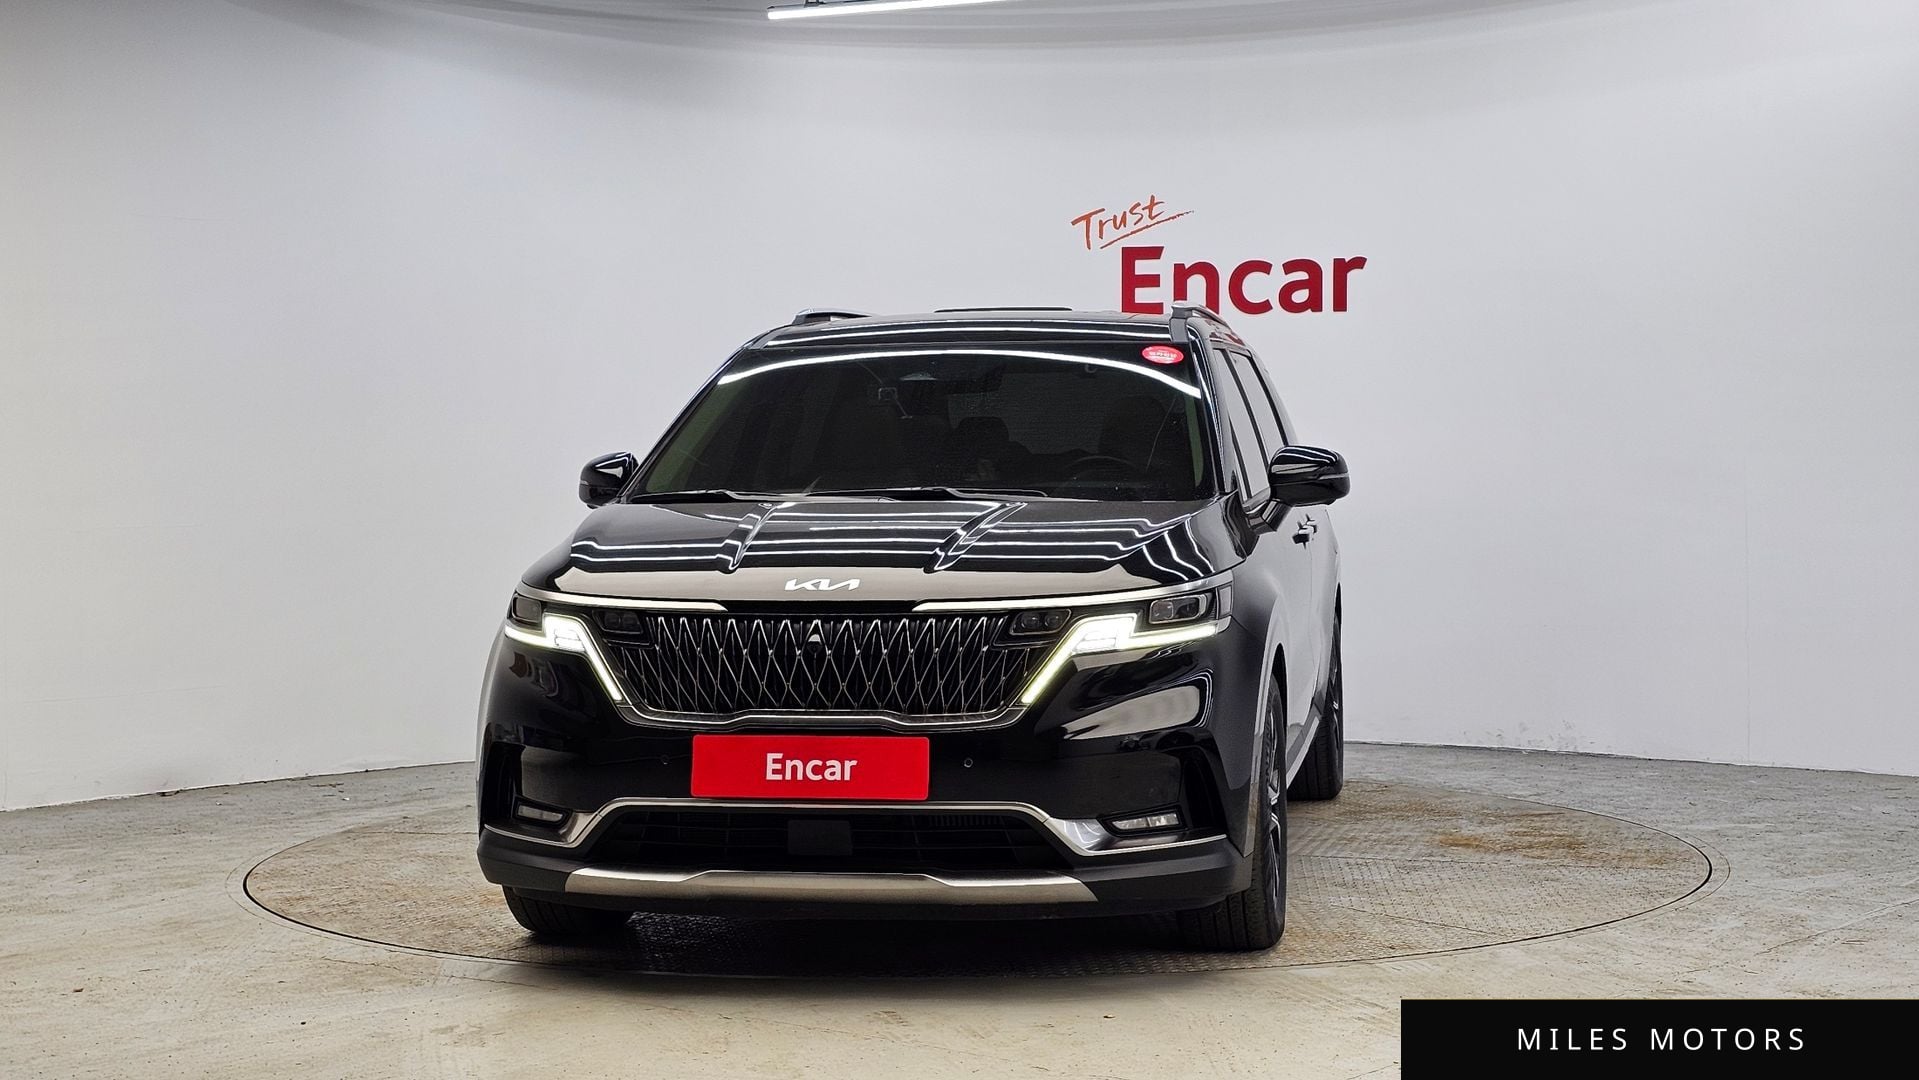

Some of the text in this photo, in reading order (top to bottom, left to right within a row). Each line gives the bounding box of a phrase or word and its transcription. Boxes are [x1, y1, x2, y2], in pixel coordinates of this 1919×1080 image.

[1071, 194, 1165, 250] Trust
[1121, 246, 1367, 315] Encar
[765, 752, 858, 782] Encar
